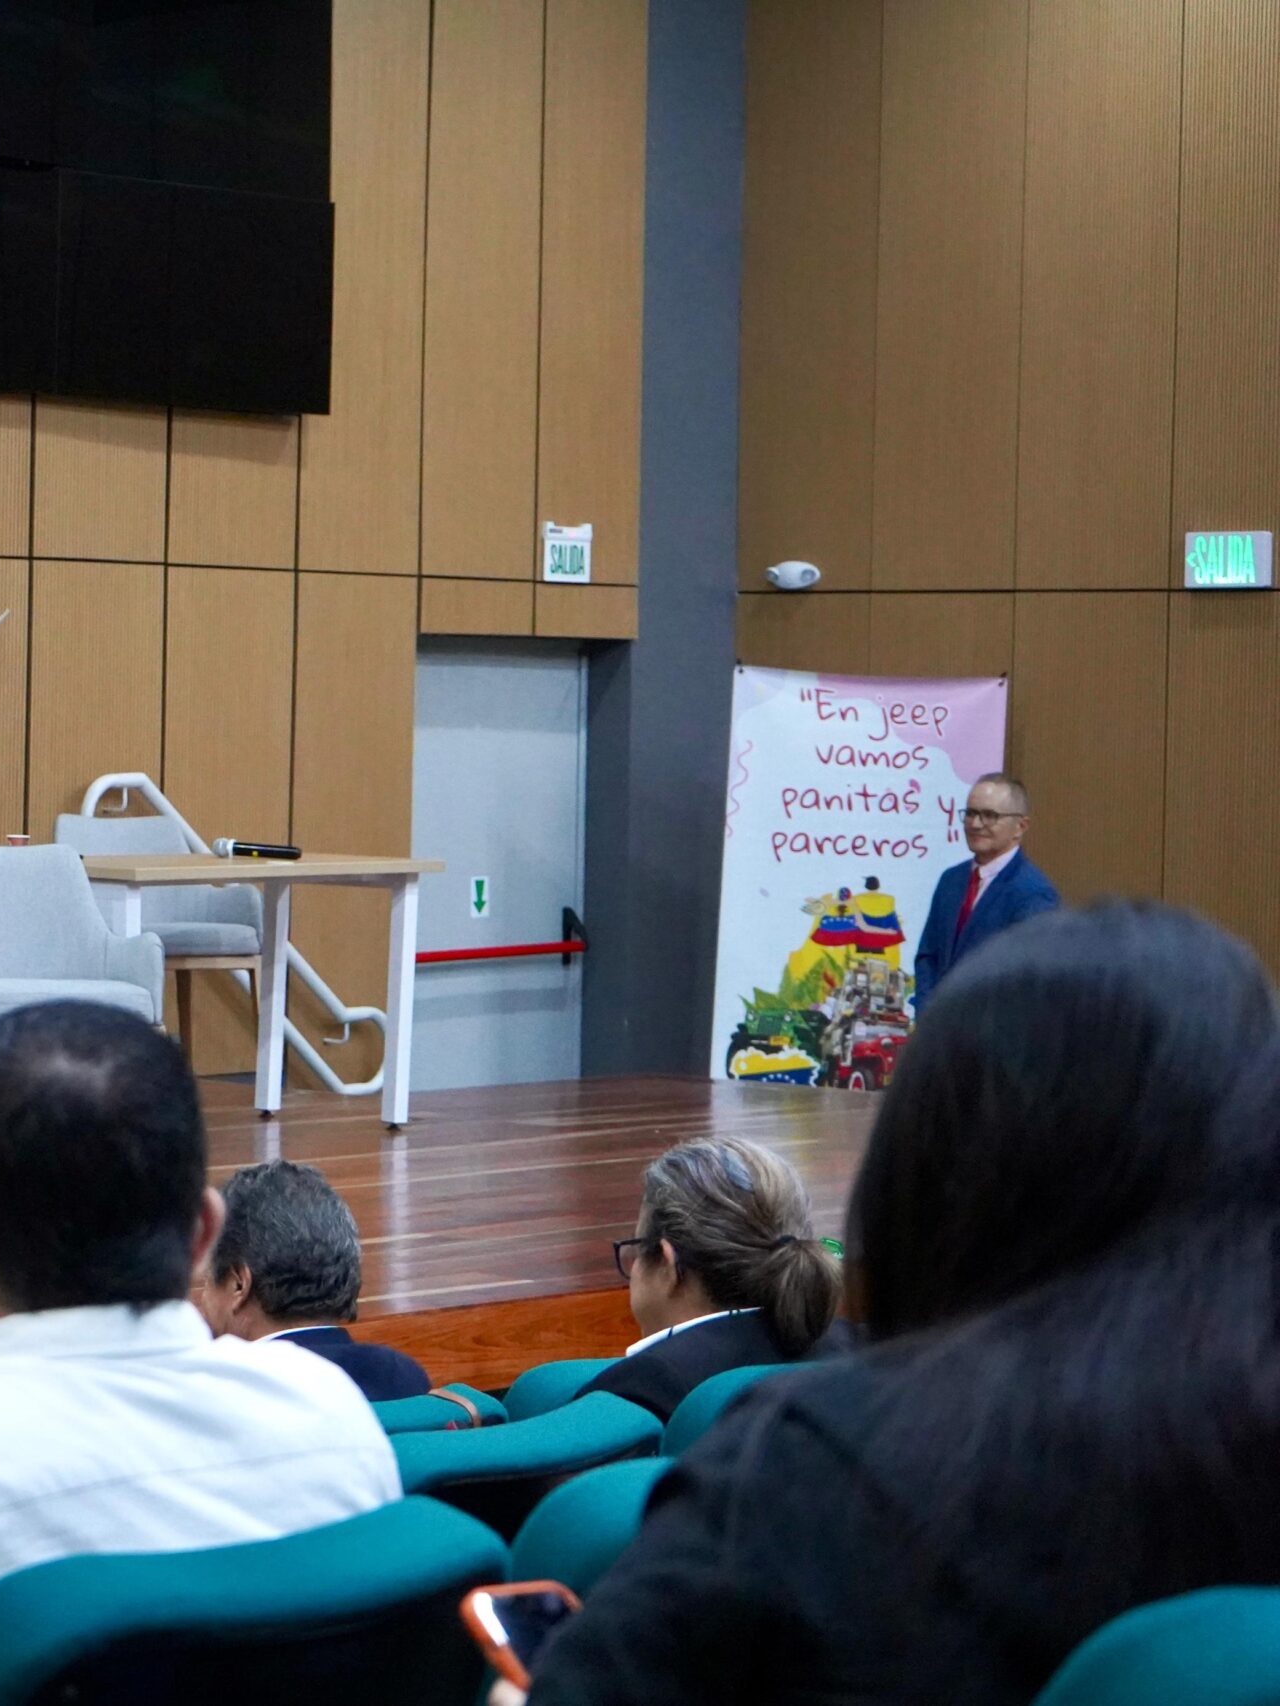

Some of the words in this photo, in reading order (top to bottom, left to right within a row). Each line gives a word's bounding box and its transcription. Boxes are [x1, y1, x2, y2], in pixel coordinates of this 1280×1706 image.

[550, 544, 585, 575] SALIDA
[1194, 534, 1256, 584] SALIDA
[800, 687, 859, 721] "En
[868, 695, 949, 741] jeep
[816, 744, 929, 770] vamos
[781, 783, 920, 819] panitas
[937, 794, 955, 827] y
[771, 831, 928, 863] parceros
